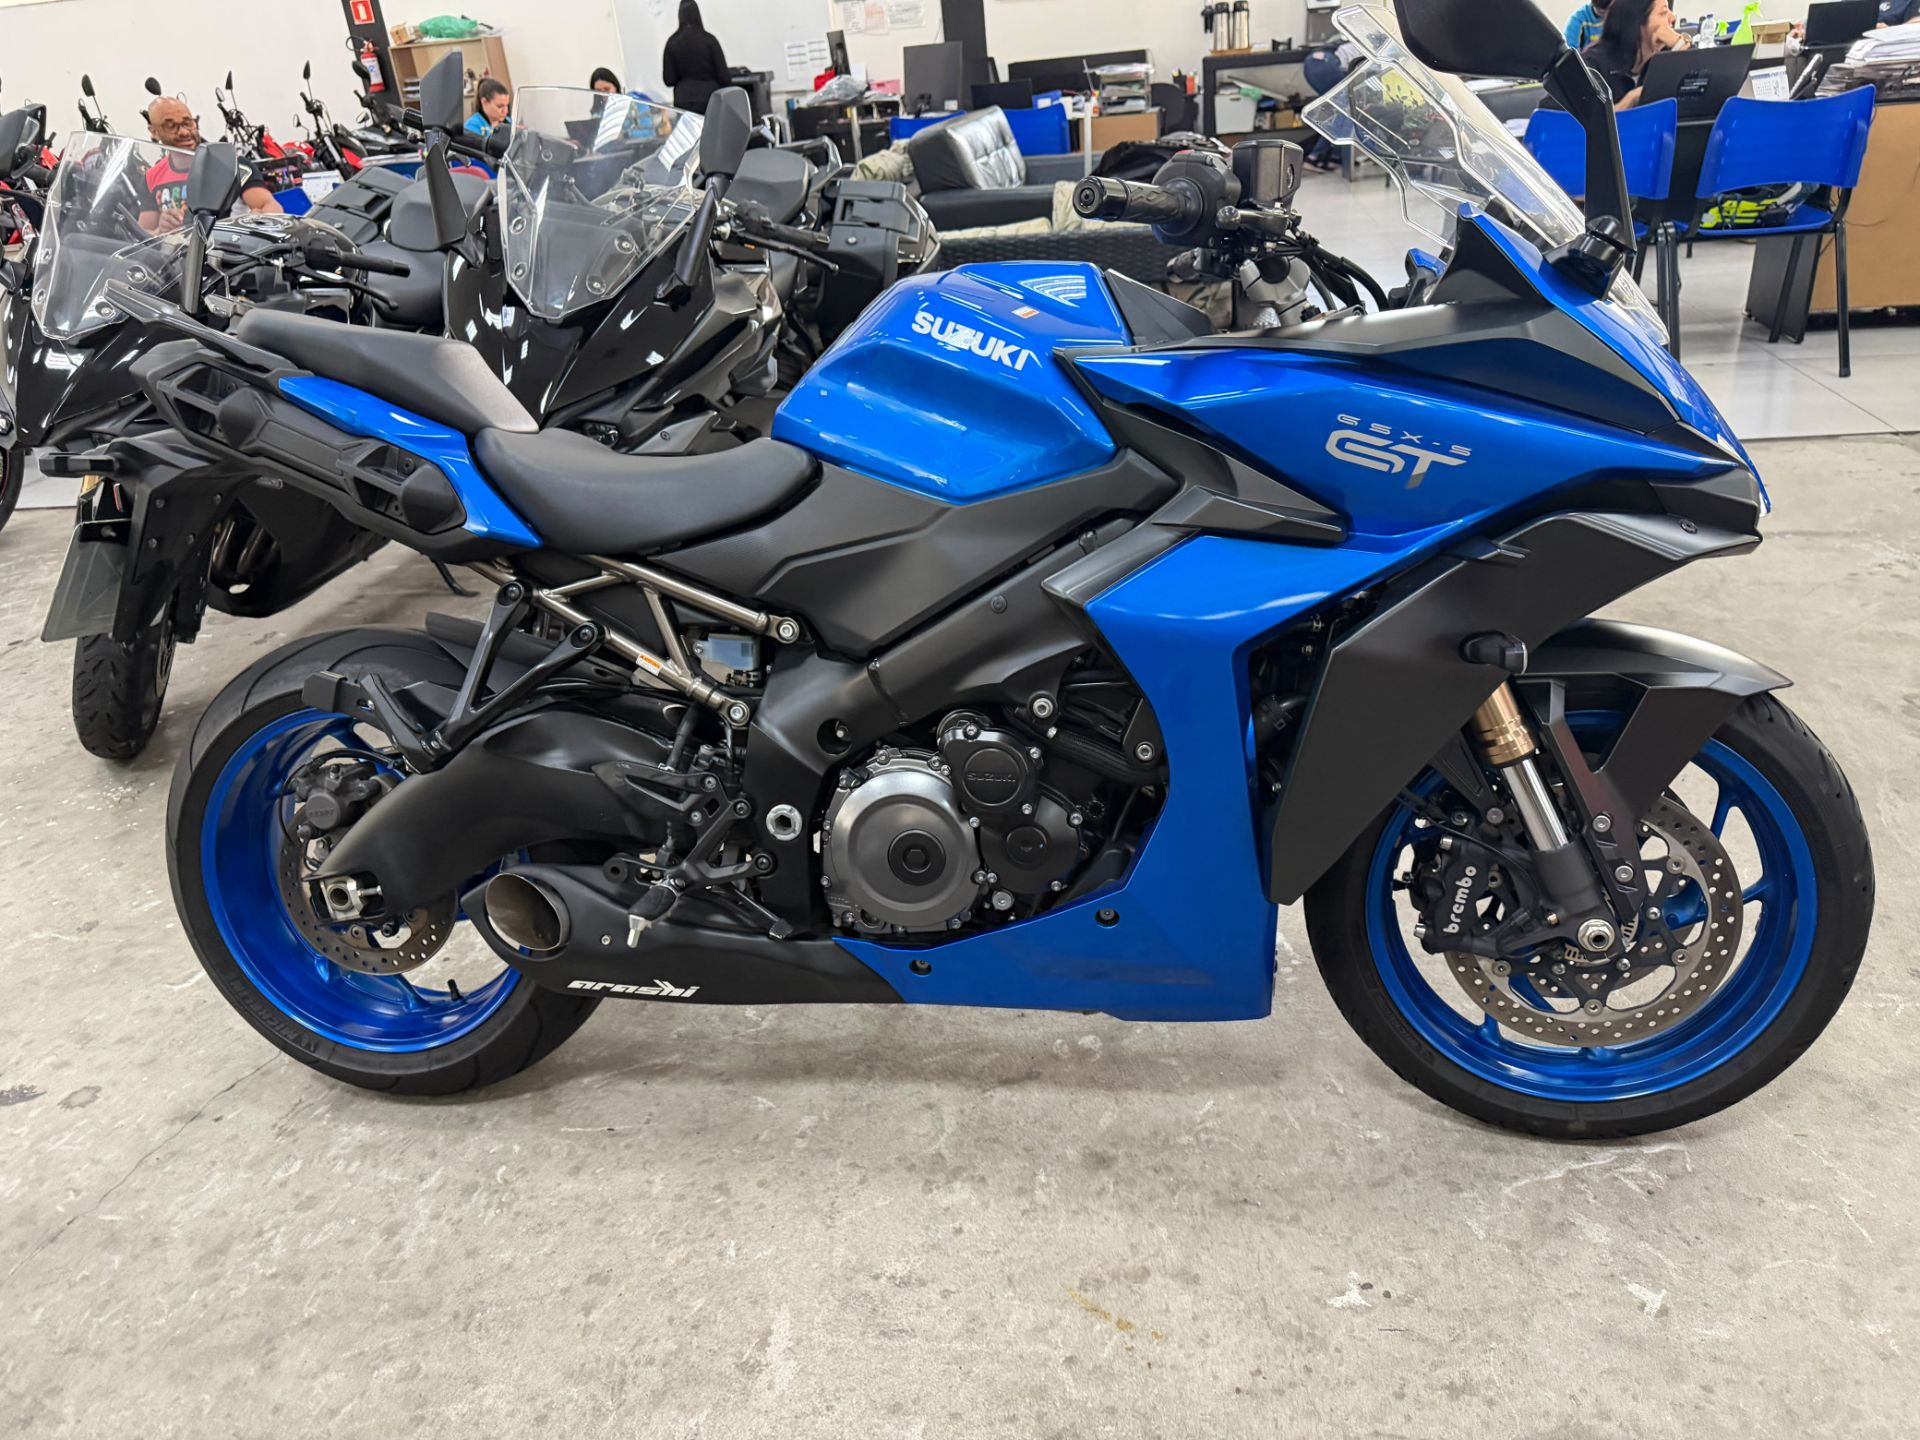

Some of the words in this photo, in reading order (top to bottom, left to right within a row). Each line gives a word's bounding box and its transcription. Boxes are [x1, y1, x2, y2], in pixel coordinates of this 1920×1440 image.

[911, 310, 1029, 371] SUZUKI
[1325, 429, 1467, 490] GT
[1336, 413, 1473, 457] GSX-S
[967, 771, 1017, 783] SUZUKI
[1442, 865, 1477, 934] brembo
[567, 978, 701, 998] arashi
